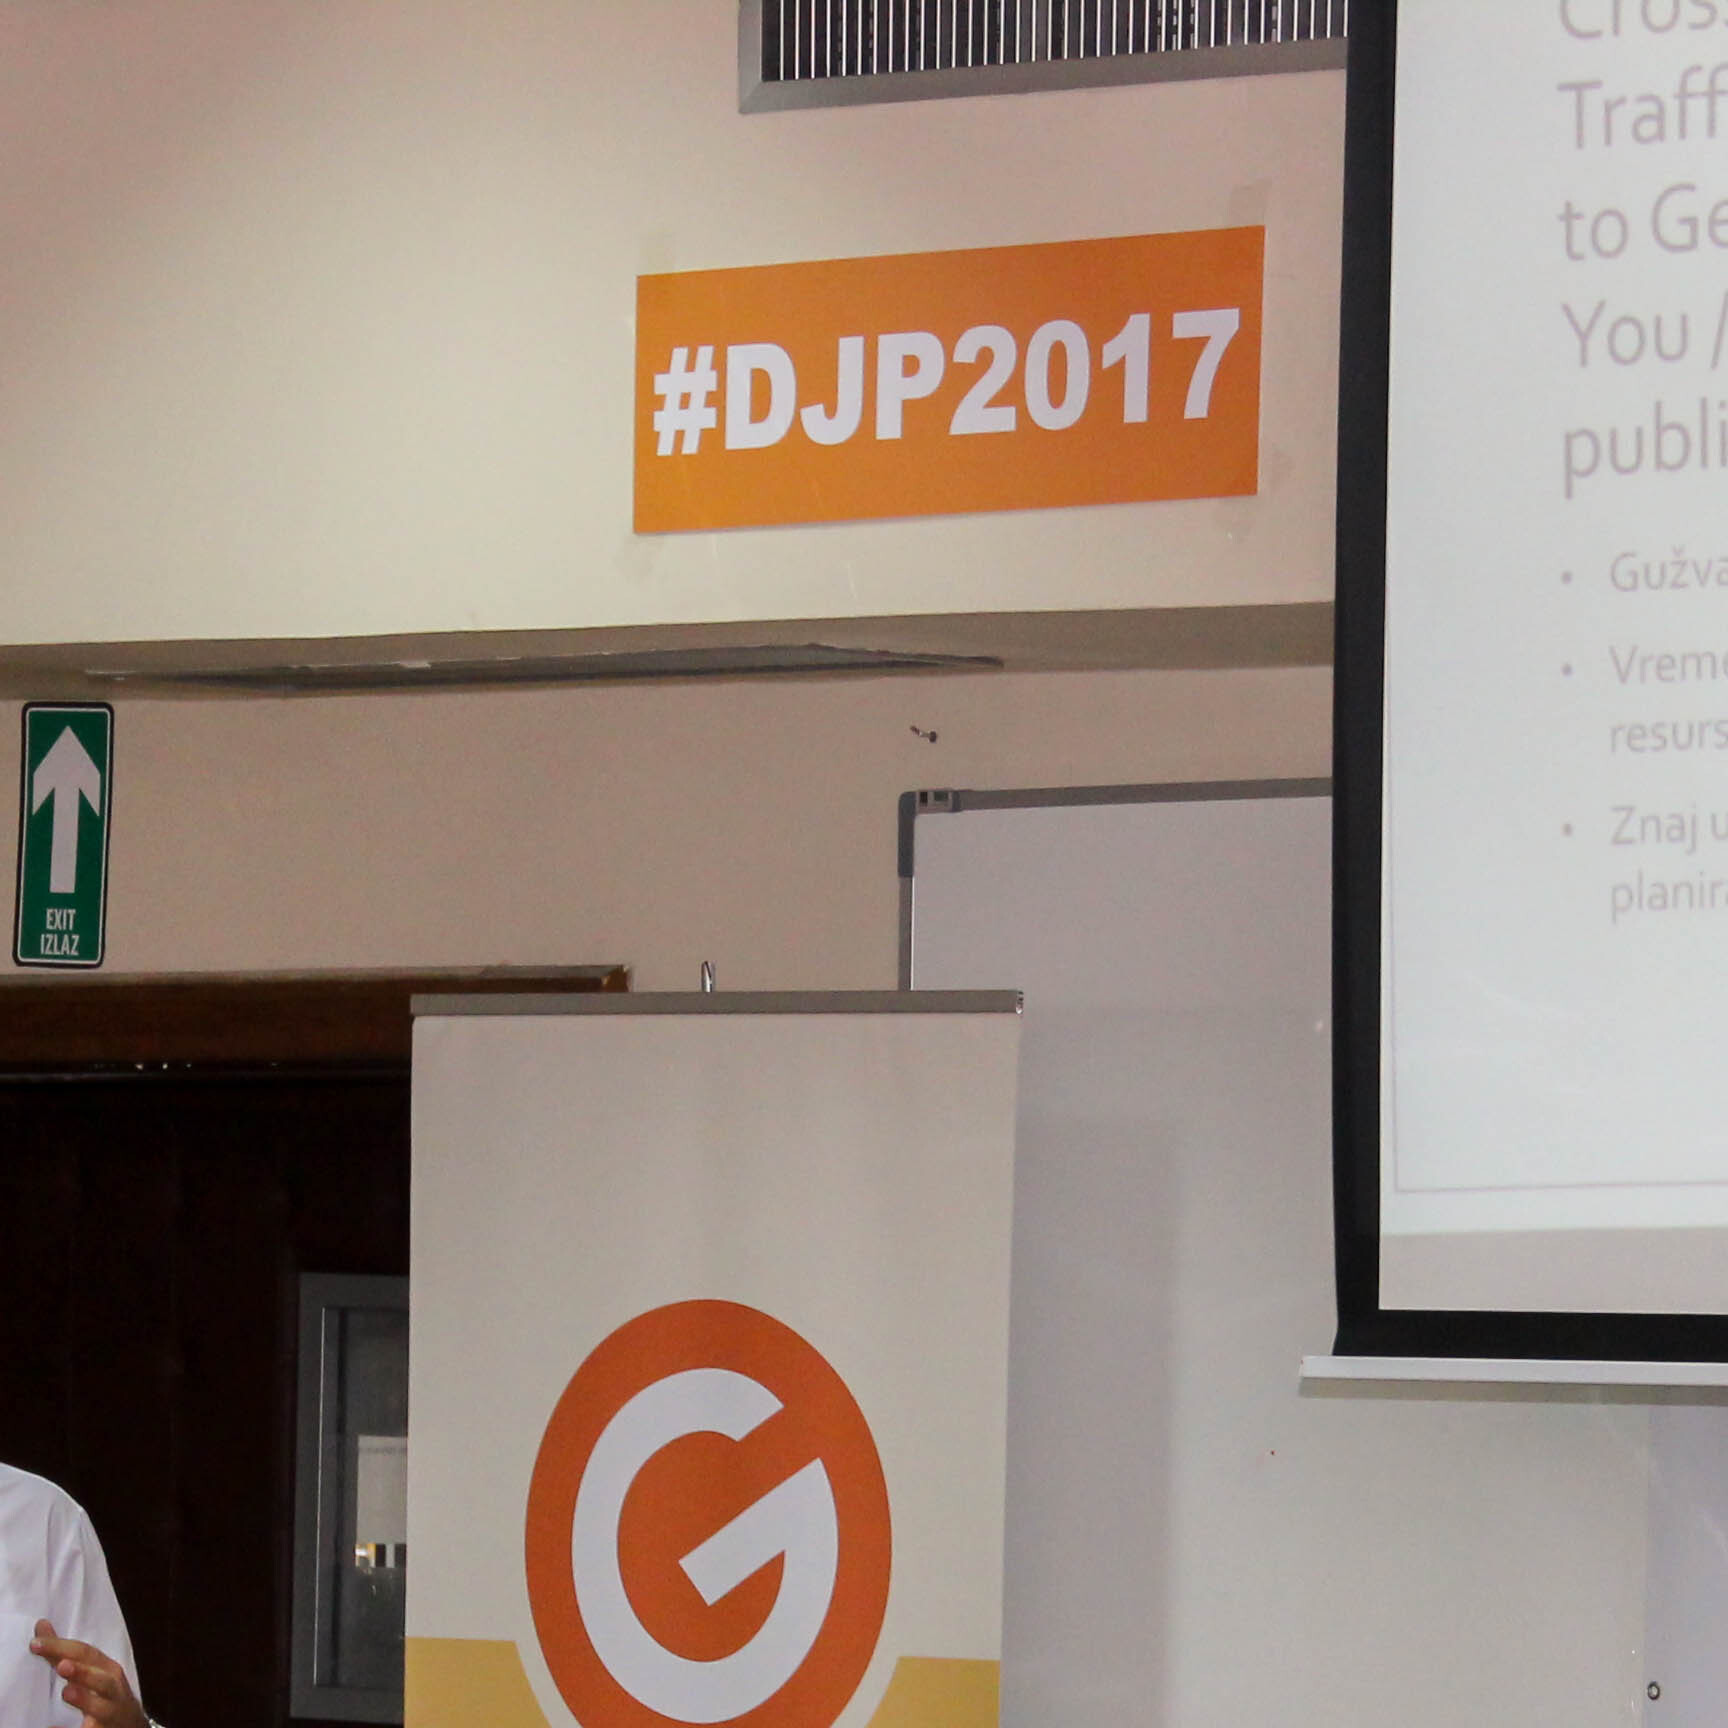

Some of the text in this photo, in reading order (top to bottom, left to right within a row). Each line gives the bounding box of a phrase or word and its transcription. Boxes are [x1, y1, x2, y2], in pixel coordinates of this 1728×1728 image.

[1558, 200, 1630, 262] to
[1560, 300, 1689, 368] You
[653, 308, 1240, 457] #DJP2017
[1610, 801, 1698, 855] Znaj
[40, 934, 80, 956] IZLAZ
[46, 908, 76, 930] EXIT
